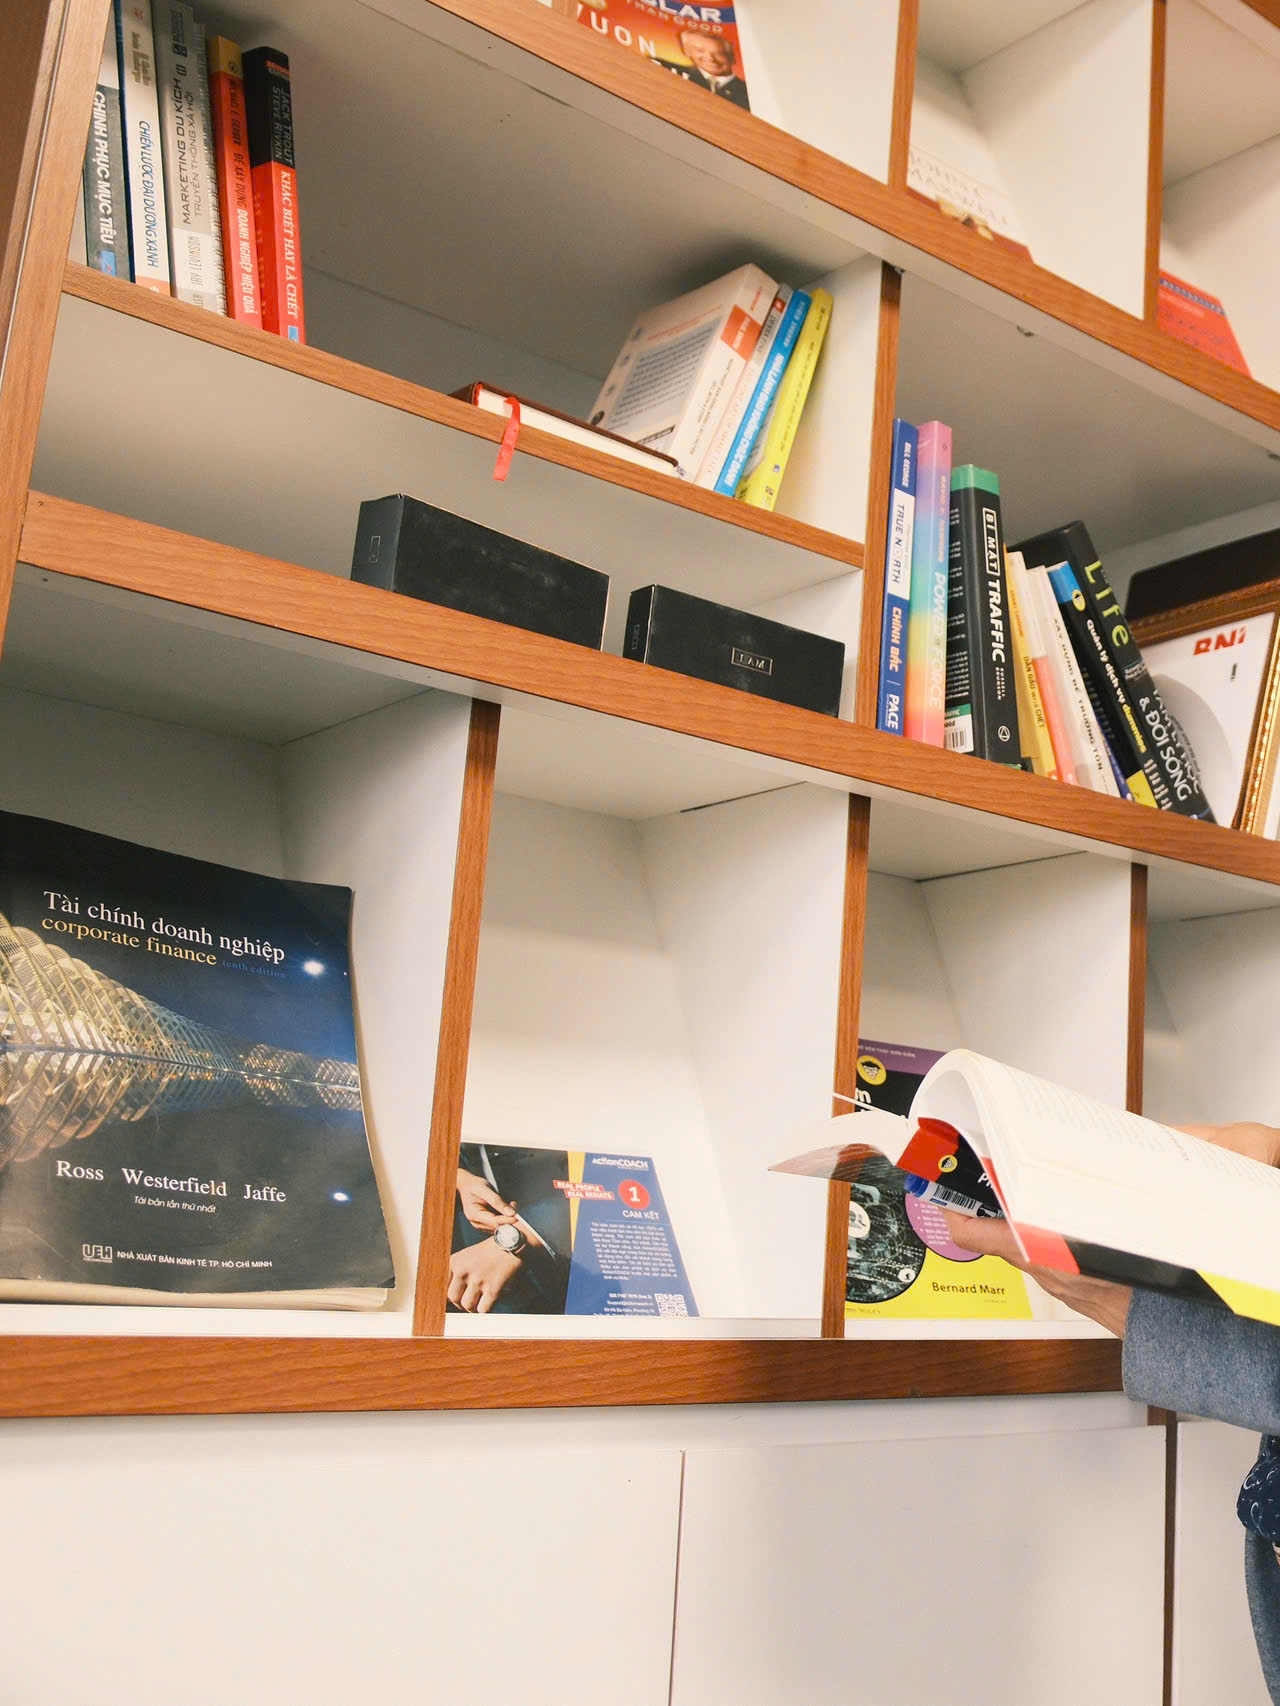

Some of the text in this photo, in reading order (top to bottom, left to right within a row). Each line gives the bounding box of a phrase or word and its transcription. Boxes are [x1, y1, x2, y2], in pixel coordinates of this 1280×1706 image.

[171, 79, 183, 109] KÍCH
[271, 86, 282, 120] STEVE
[176, 110, 185, 137] DU
[274, 123, 284, 161] RIVKIN
[280, 88, 293, 166] JACK TROUT
[177, 140, 192, 225] MARKETING
[237, 209, 249, 239] DOANH
[147, 239, 158, 268] XANH
[284, 240, 296, 262] HAY
[901, 460, 911, 488] GEORGE
[897, 505, 906, 536] TRUE
[929, 571, 948, 634] POWER
[1084, 559, 1129, 647] Life
[890, 606, 903, 645] CHÍNH
[987, 579, 1005, 664] TRAFFIC
[926, 645, 942, 708] FORCE
[1087, 619, 1148, 753] Quản lý dịch vụ dummies
[886, 693, 900, 729] PACE
[1139, 696, 1151, 711] &
[1145, 709, 1170, 747] ĐỜI
[1160, 746, 1193, 801] SỐNG
[41, 917, 218, 965] corporate finance
[43, 890, 286, 964] Tài chính doanh nghiệp
[55, 1160, 287, 1203] Ross Westerfield Jaffe
[629, 1186, 641, 1202] 1
[622, 1209, 643, 1219] CAM
[117, 1250, 135, 1260] NHÀ
[135, 1251, 157, 1262] XUẤT
[176, 1256, 196, 1266] KINH
[197, 1257, 208, 1267] TẾ
[209, 1259, 221, 1268] TP.
[251, 1260, 273, 1268] MINH
[932, 1281, 1006, 1296] Bernard Marr
